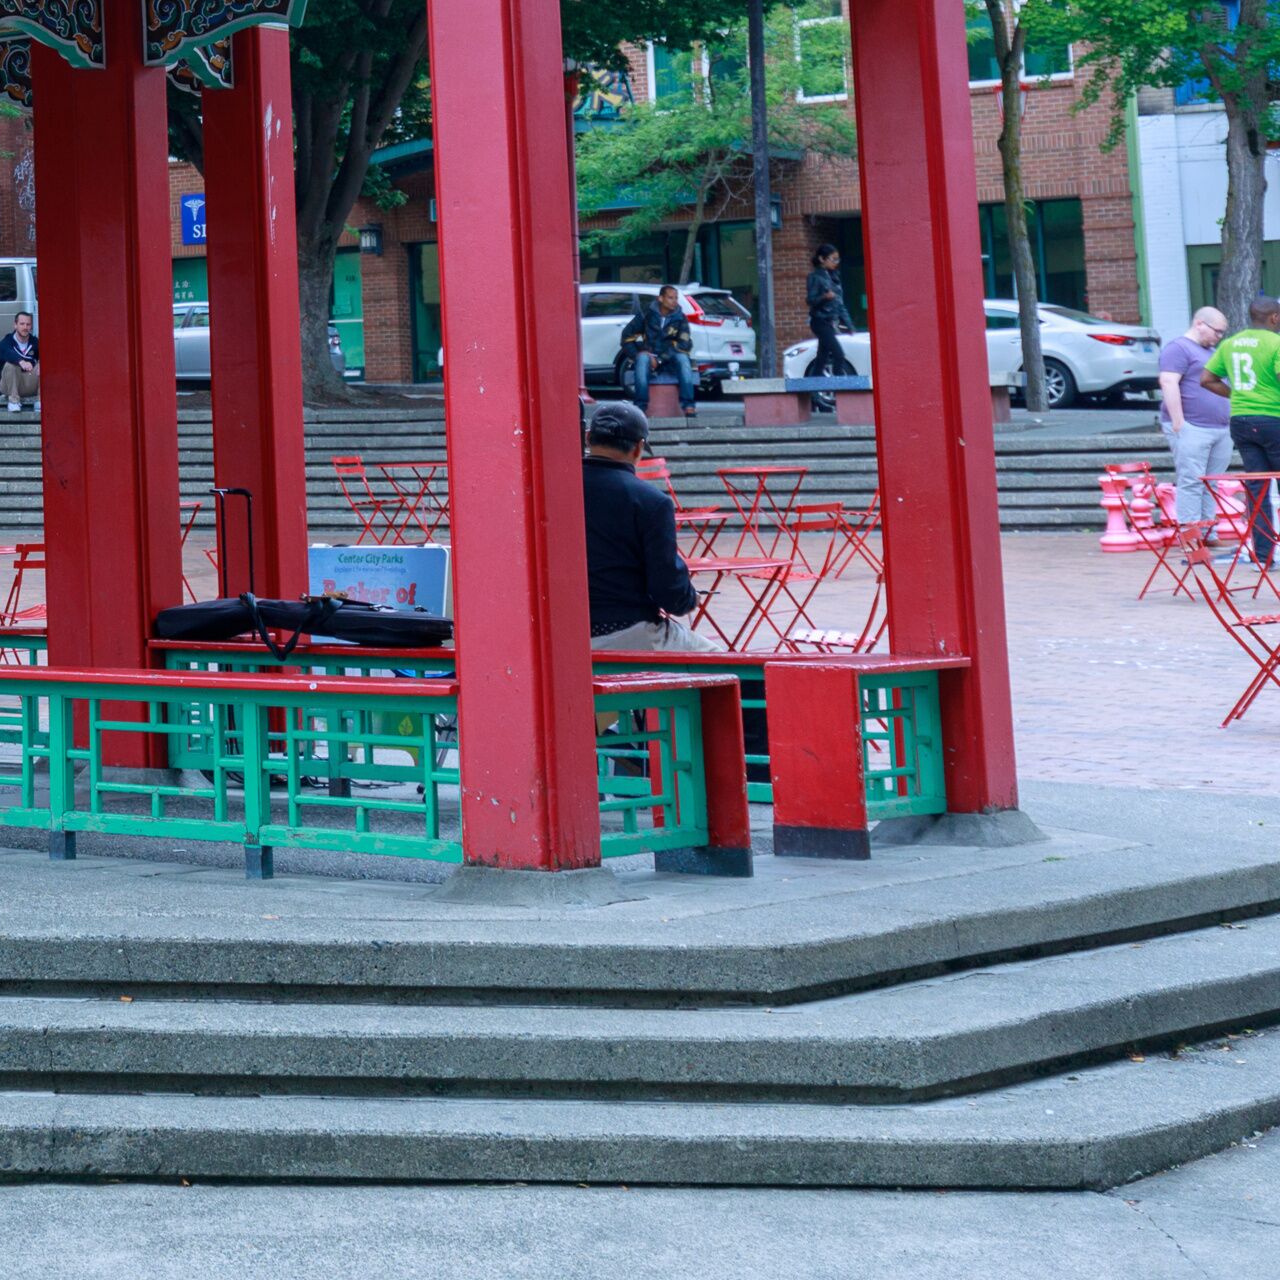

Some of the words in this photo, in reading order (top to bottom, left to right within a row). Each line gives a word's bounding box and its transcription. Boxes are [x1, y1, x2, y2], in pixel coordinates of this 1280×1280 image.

[1232, 352, 1257, 391] 13
[338, 553, 363, 564] Center
[365, 553, 380, 566] City
[382, 553, 404, 564] Parks
[323, 579, 390, 603] Bsker
[396, 582, 417, 605] of
